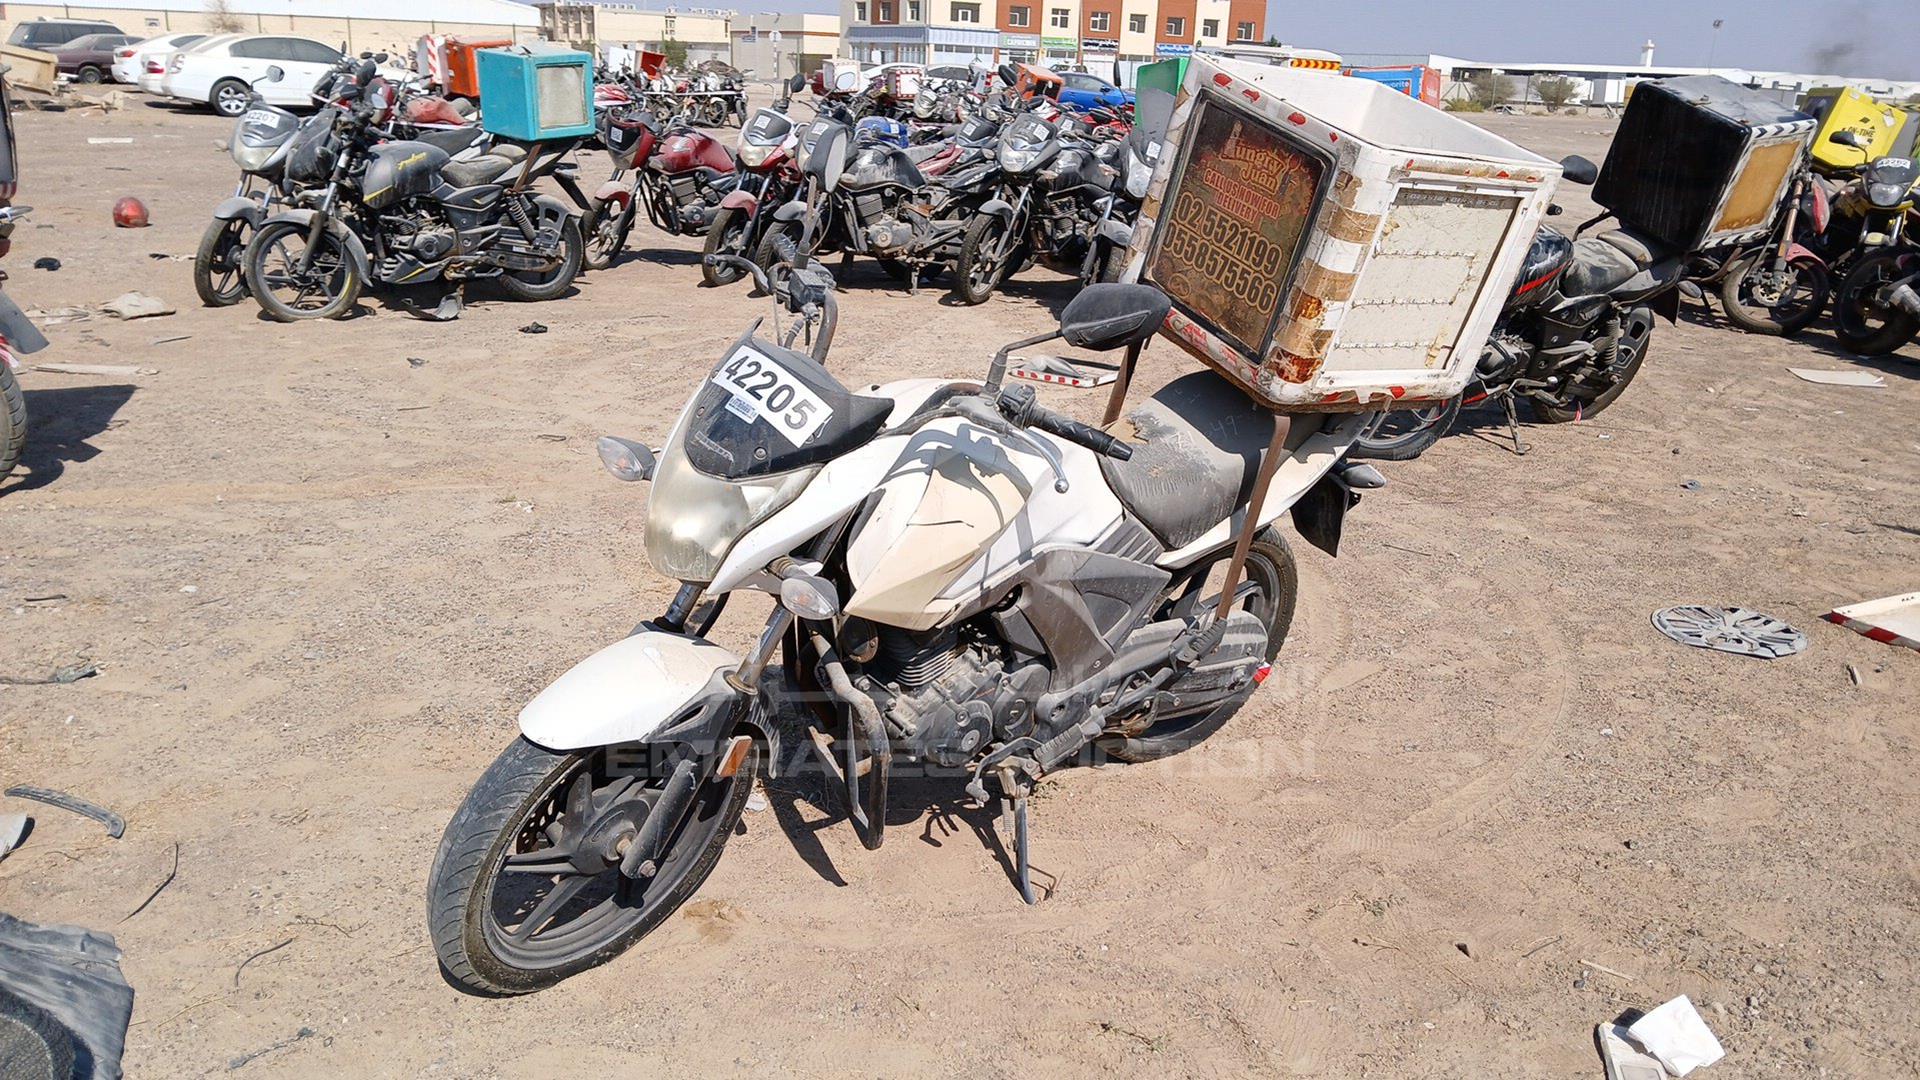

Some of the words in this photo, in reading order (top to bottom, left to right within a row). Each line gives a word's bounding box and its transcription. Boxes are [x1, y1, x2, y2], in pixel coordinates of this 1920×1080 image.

[1847, 126, 1876, 137] ON-TIME
[1240, 161, 1277, 190] Juan
[1216, 191, 1258, 223] DELIVERY
[1177, 192, 1204, 234] 02
[1201, 205, 1282, 278] 5521199
[1162, 219, 1277, 313] 0558575566
[725, 355, 818, 430] 42205
